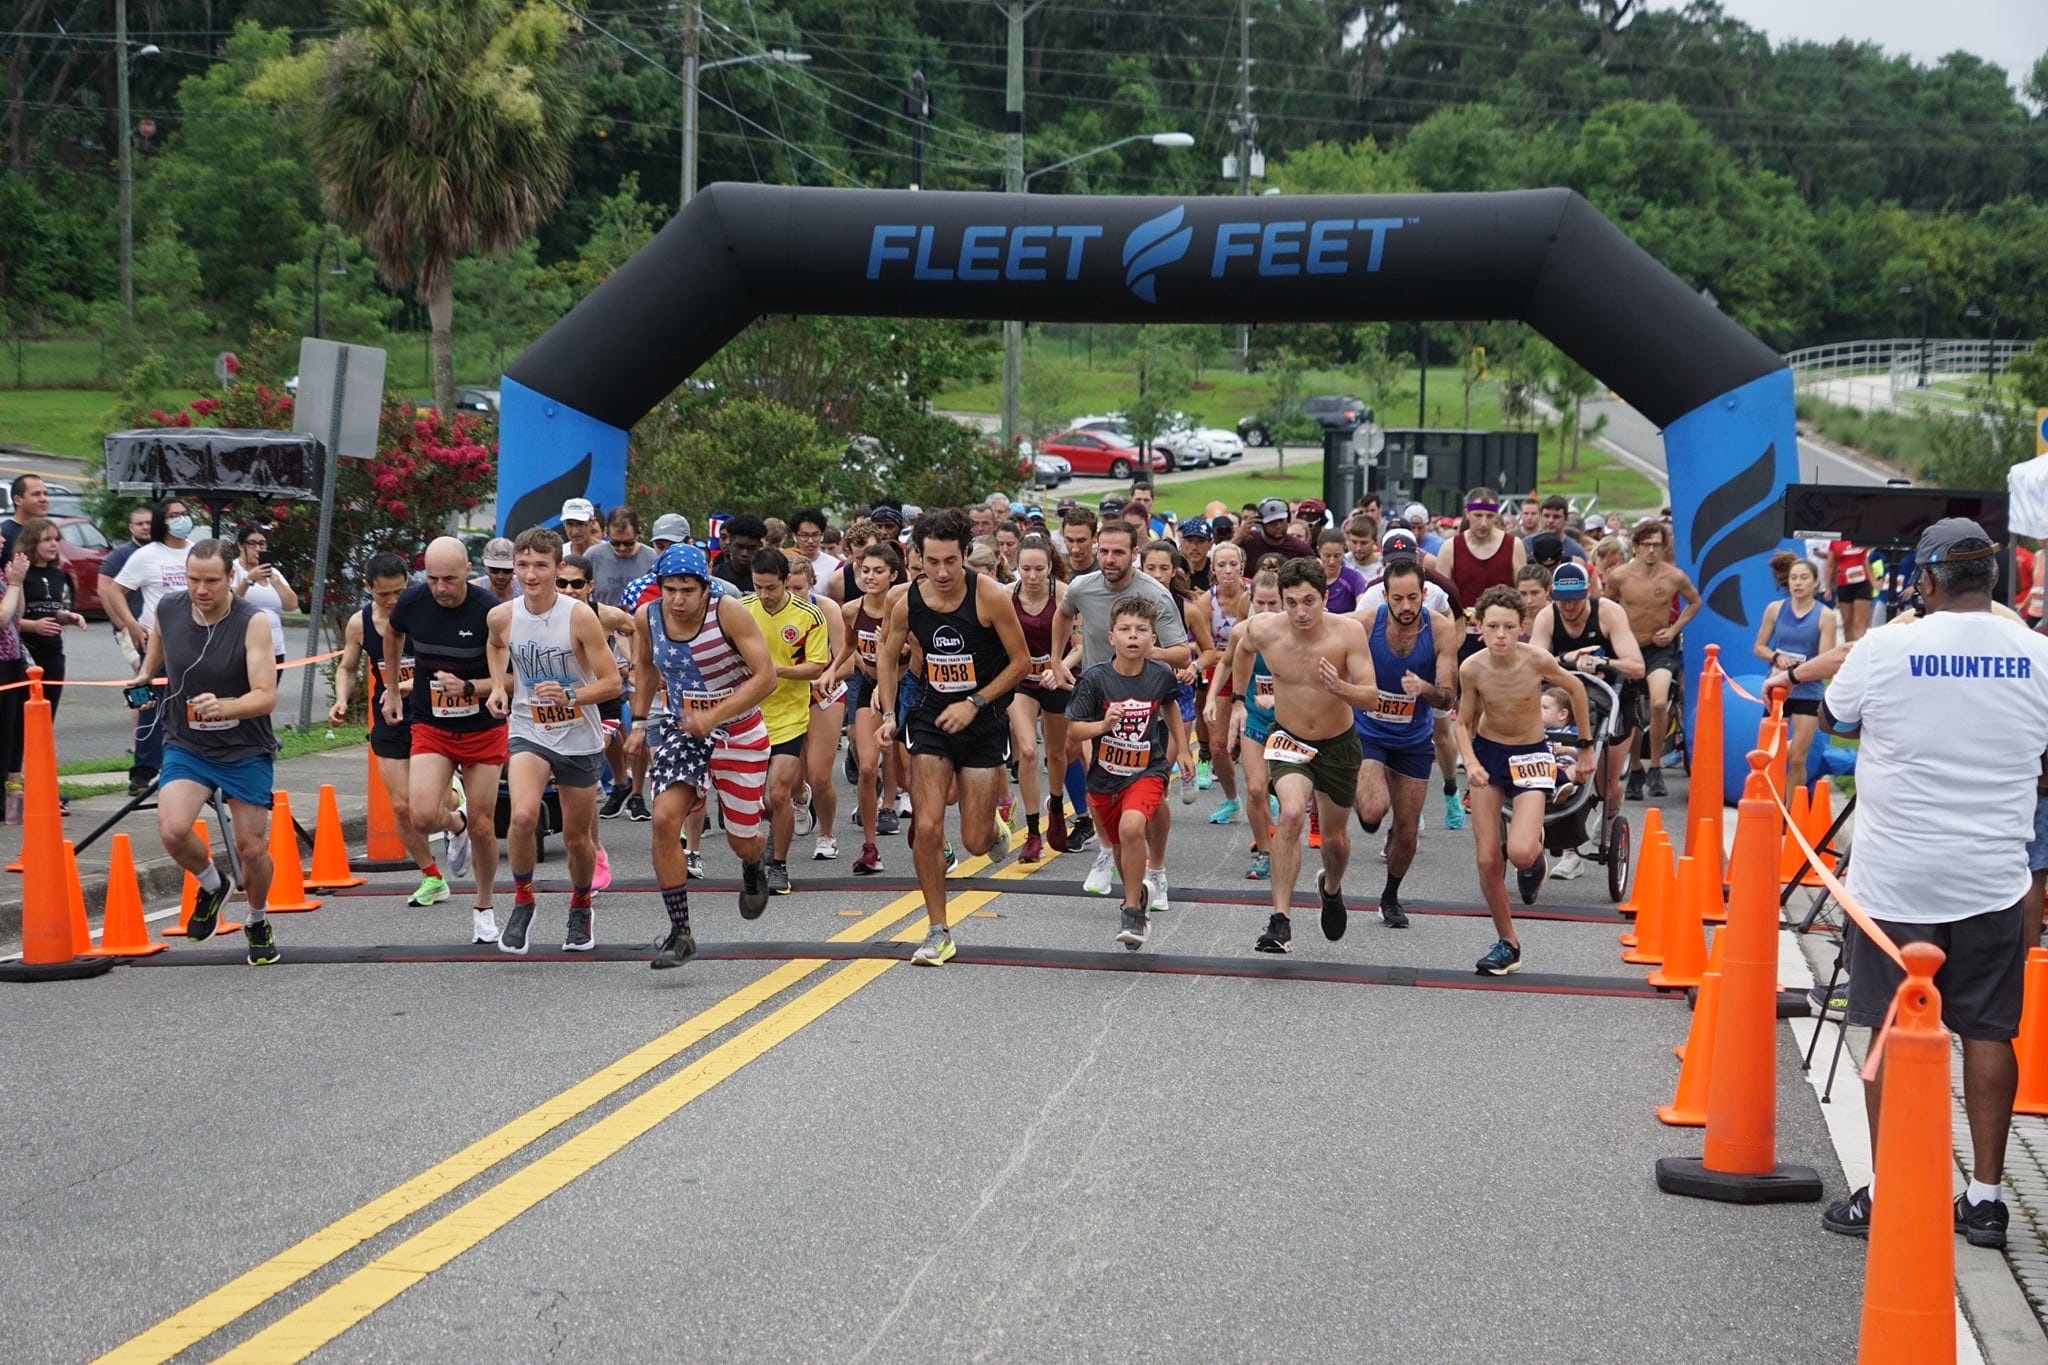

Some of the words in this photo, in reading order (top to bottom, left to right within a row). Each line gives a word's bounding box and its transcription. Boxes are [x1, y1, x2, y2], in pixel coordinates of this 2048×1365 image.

[866, 225, 1103, 280] FLEET
[1211, 218, 1403, 278] FEET
[933, 664, 969, 682] 7958
[1909, 655, 2031, 678] VOLUNTEER
[1105, 745, 1142, 767] 8011
[1518, 761, 1551, 778] 8007
